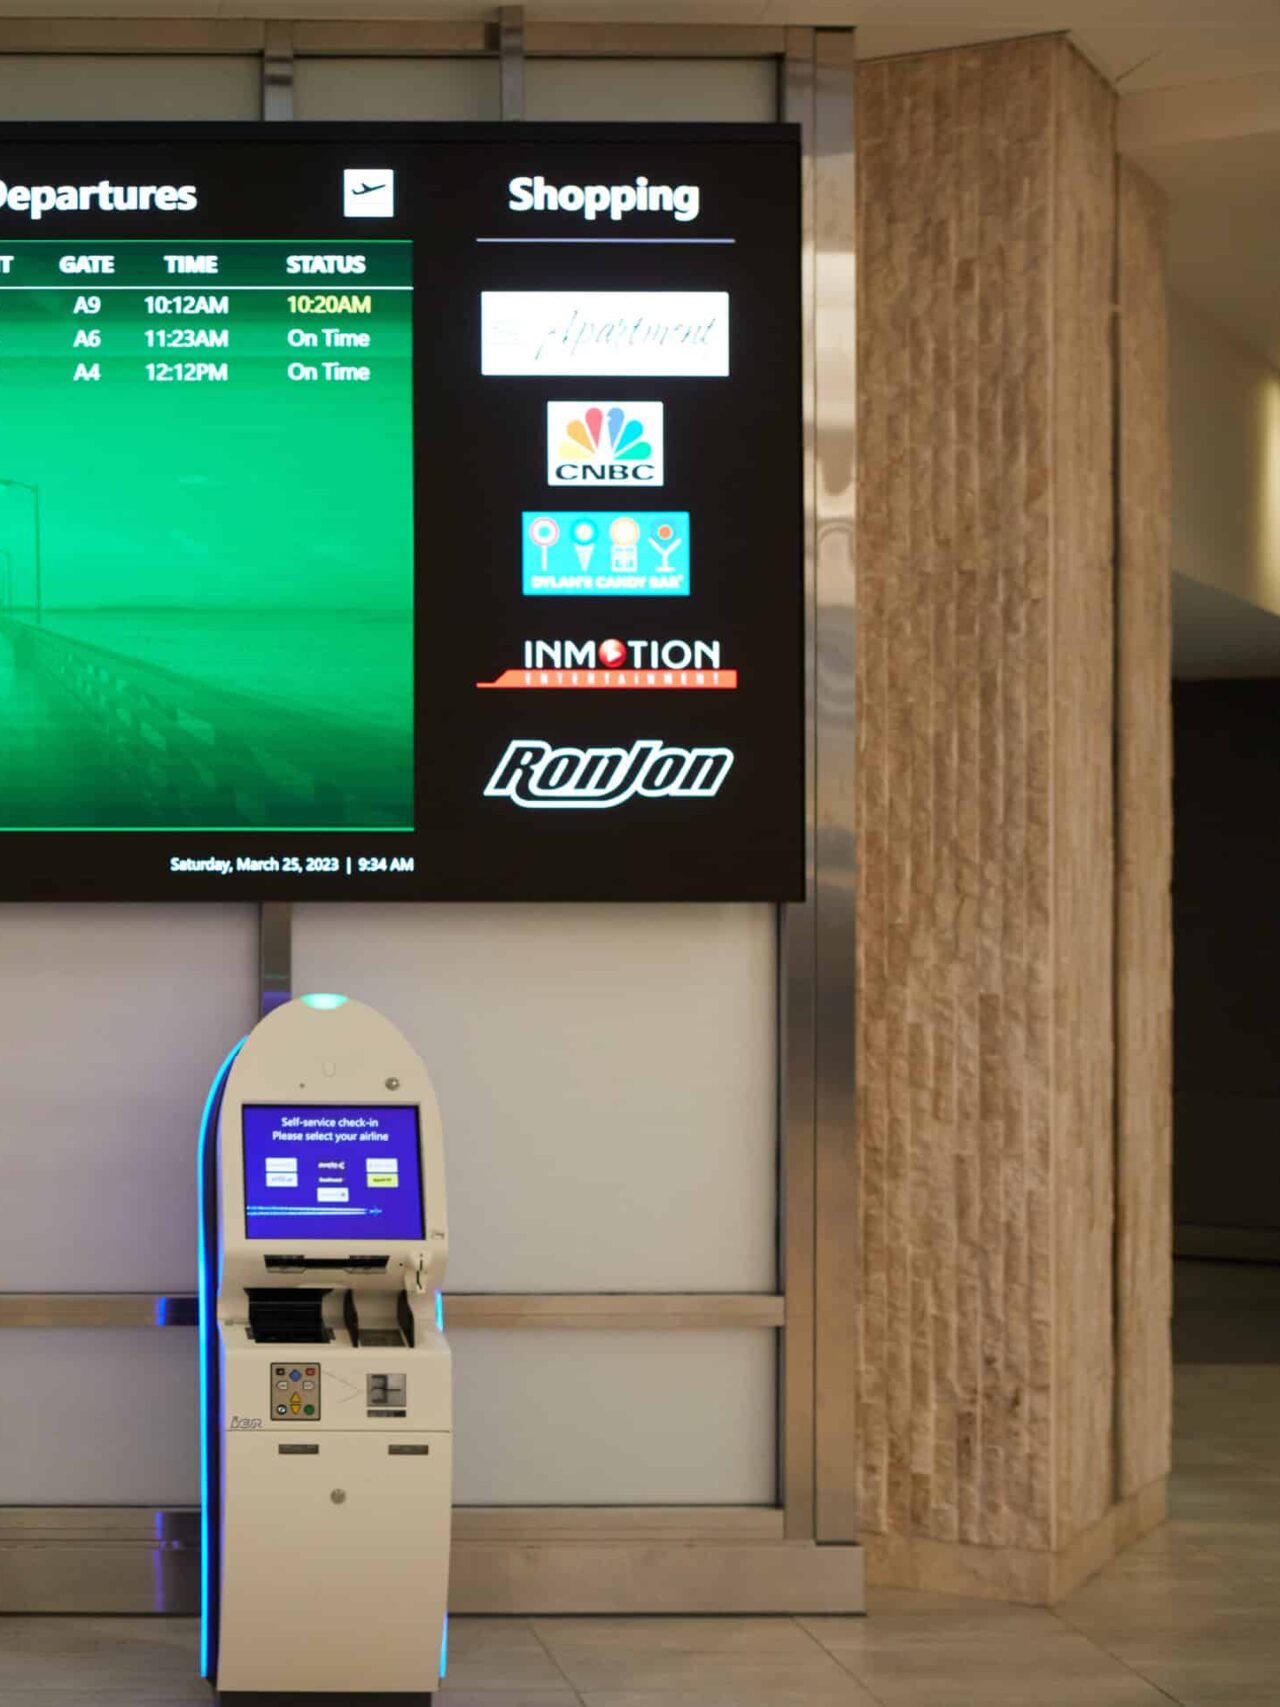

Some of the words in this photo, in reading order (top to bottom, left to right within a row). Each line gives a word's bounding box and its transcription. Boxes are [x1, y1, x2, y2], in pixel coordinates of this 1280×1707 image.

[508, 176, 700, 221] Shopping
[59, 255, 115, 274] GATE
[164, 255, 218, 274] TIME
[286, 255, 366, 274] STATUS
[73, 296, 101, 314] A9
[145, 296, 229, 314] 10:12AM
[287, 295, 372, 314] 10:20AM
[73, 329, 101, 348] A6
[145, 329, 229, 348] 11:23AM
[287, 329, 318, 348] On
[322, 329, 371, 348] Time
[73, 363, 101, 381] A4
[146, 362, 229, 381] 12:12PM
[287, 362, 318, 381] On
[322, 362, 371, 381] Time
[555, 464, 656, 481] CNBC
[595, 575, 646, 589] CANDY
[649, 575, 682, 589] BAR
[524, 671, 720, 686] ENTERTAINMENT
[170, 857, 233, 874] Saturday,
[236, 857, 279, 872] March
[282, 857, 303, 874] 25,
[306, 857, 339, 872] 2023
[358, 857, 387, 872] 9:34
[389, 857, 414, 872] AM
[281, 1117, 336, 1128] Self-service
[338, 1117, 379, 1128] check-in
[272, 1131, 303, 1142] Please
[305, 1131, 334, 1142] select
[335, 1133, 357, 1143] your
[359, 1131, 389, 1142] airline
